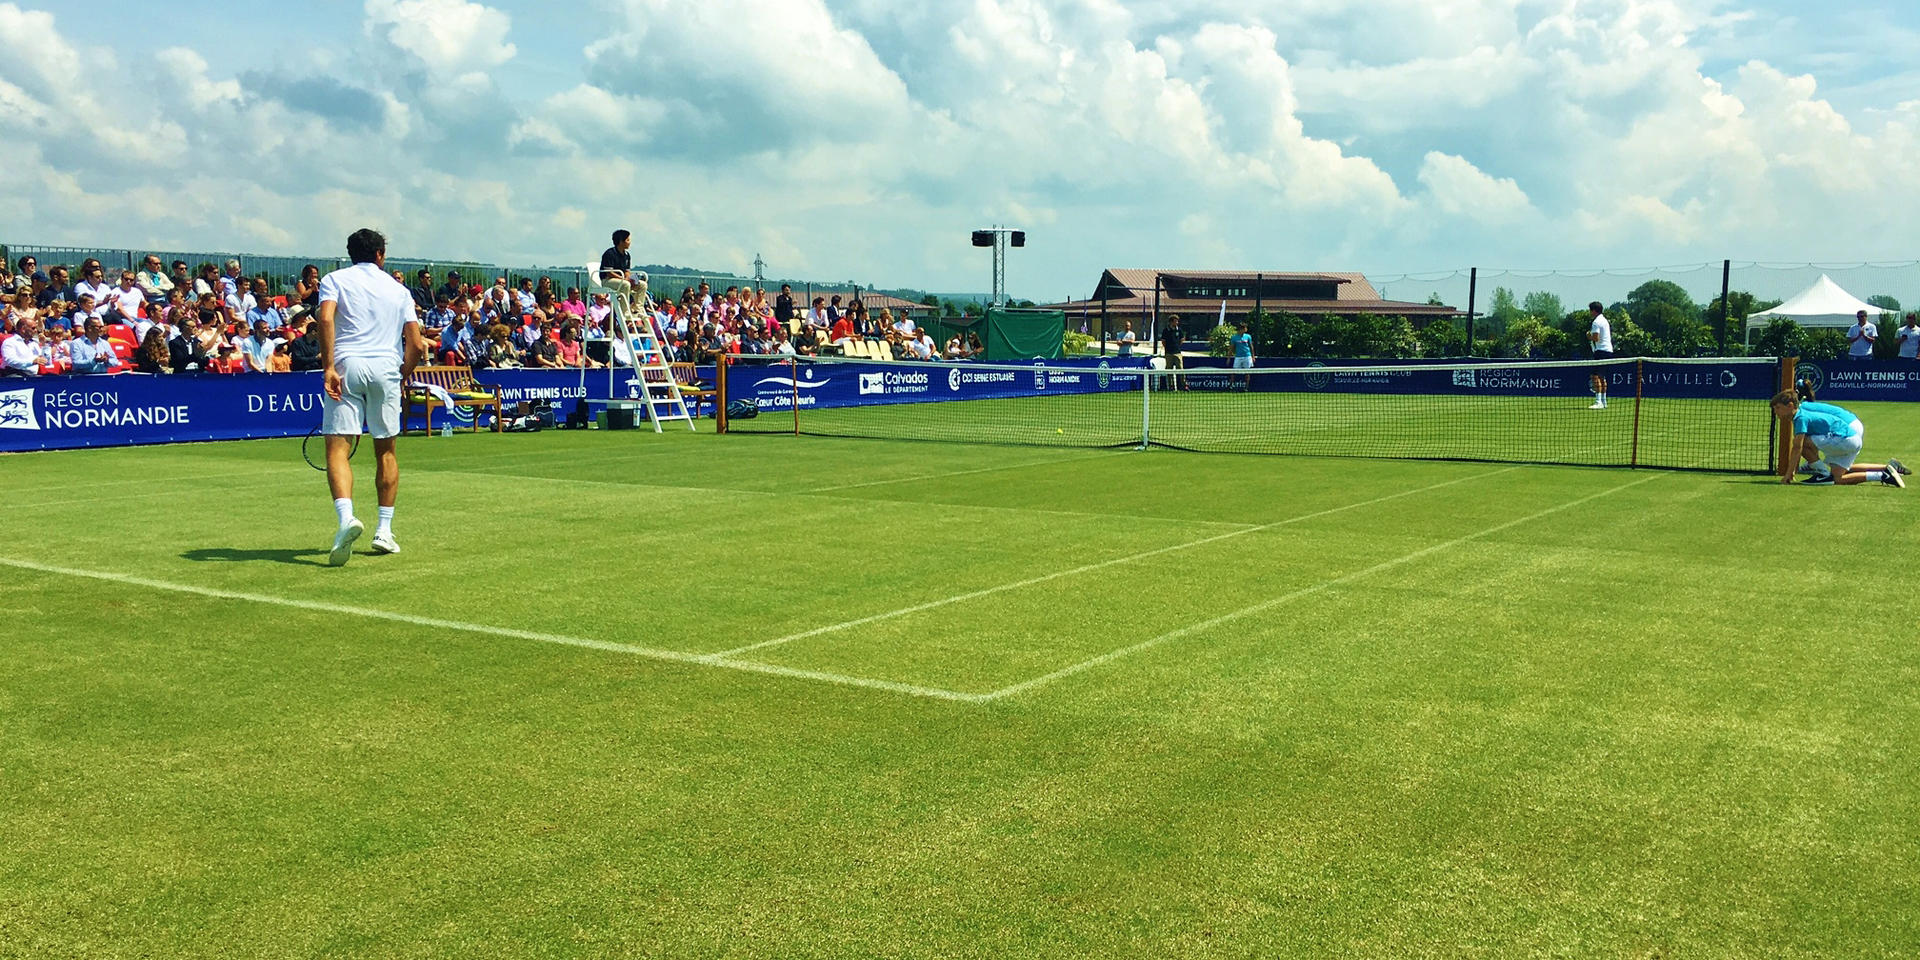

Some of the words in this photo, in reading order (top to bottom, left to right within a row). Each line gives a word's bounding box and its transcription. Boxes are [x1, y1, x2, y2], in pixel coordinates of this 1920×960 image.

[885, 371, 928, 384] Calvados
[962, 373, 973, 383] CCI
[974, 373, 989, 382] SEINE
[989, 372, 1015, 382] ESTUAIRE
[1830, 371, 1861, 381] LAWN
[1865, 371, 1906, 381] TENNIS
[1908, 371, 1920, 381] CL
[1480, 378, 1561, 388] NORMANDIE
[524, 387, 560, 399] TENNIS
[562, 386, 587, 398] CLUB
[885, 386, 891, 394] LE
[893, 385, 928, 393] DÉPARTEMENT
[44, 390, 118, 408] RÉGION
[247, 393, 325, 413] DEAUV
[774, 395, 791, 406] Côte
[45, 405, 189, 429] NORMANDIE
